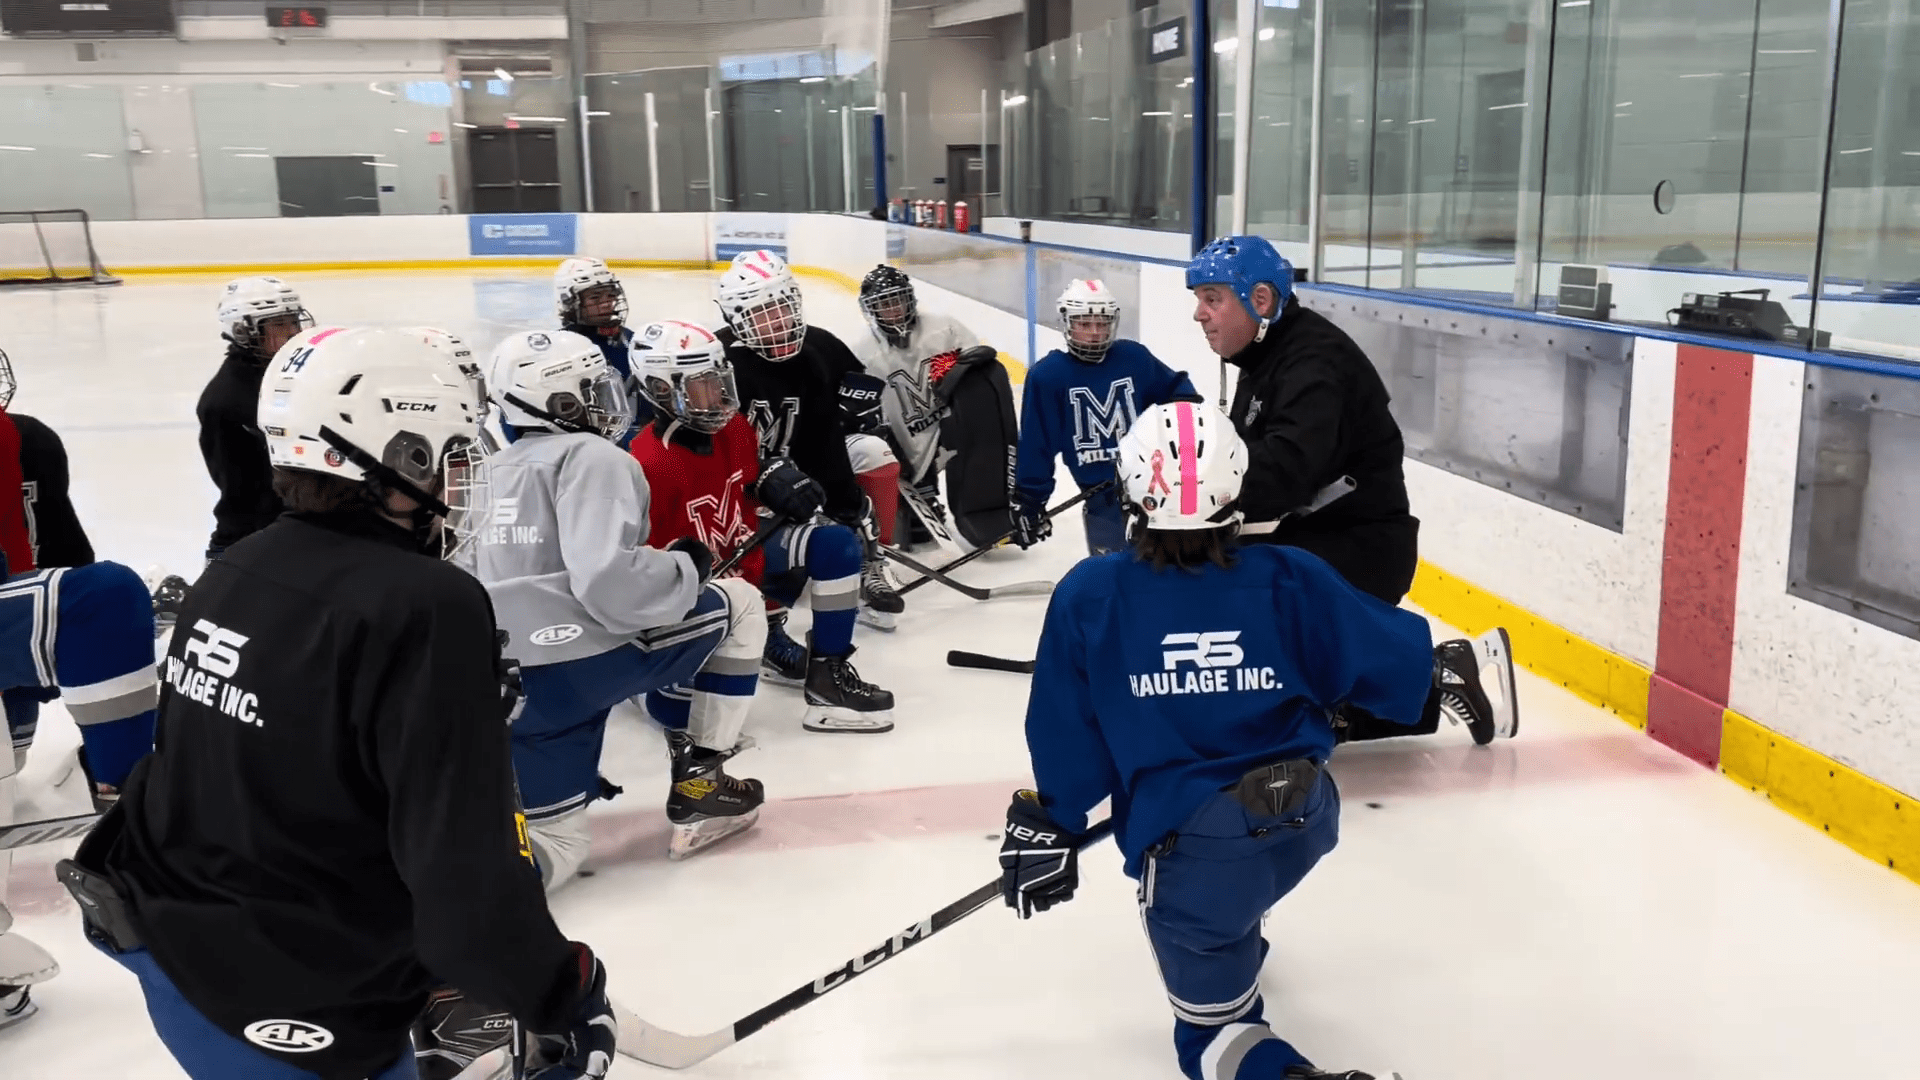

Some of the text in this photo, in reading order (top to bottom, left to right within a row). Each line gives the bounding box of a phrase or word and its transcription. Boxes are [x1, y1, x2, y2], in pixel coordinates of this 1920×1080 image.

[281, 347, 315, 373] 34
[396, 402, 438, 413] CCM
[747, 397, 800, 459] M
[1069, 376, 1136, 450] M
[512, 525, 544, 544] INC.
[184, 618, 250, 678] RS
[1161, 630, 1244, 670] RS
[1129, 667, 1283, 697] HAULAGE INC.
[220, 683, 264, 727] INC.
[813, 916, 932, 994] CCM
